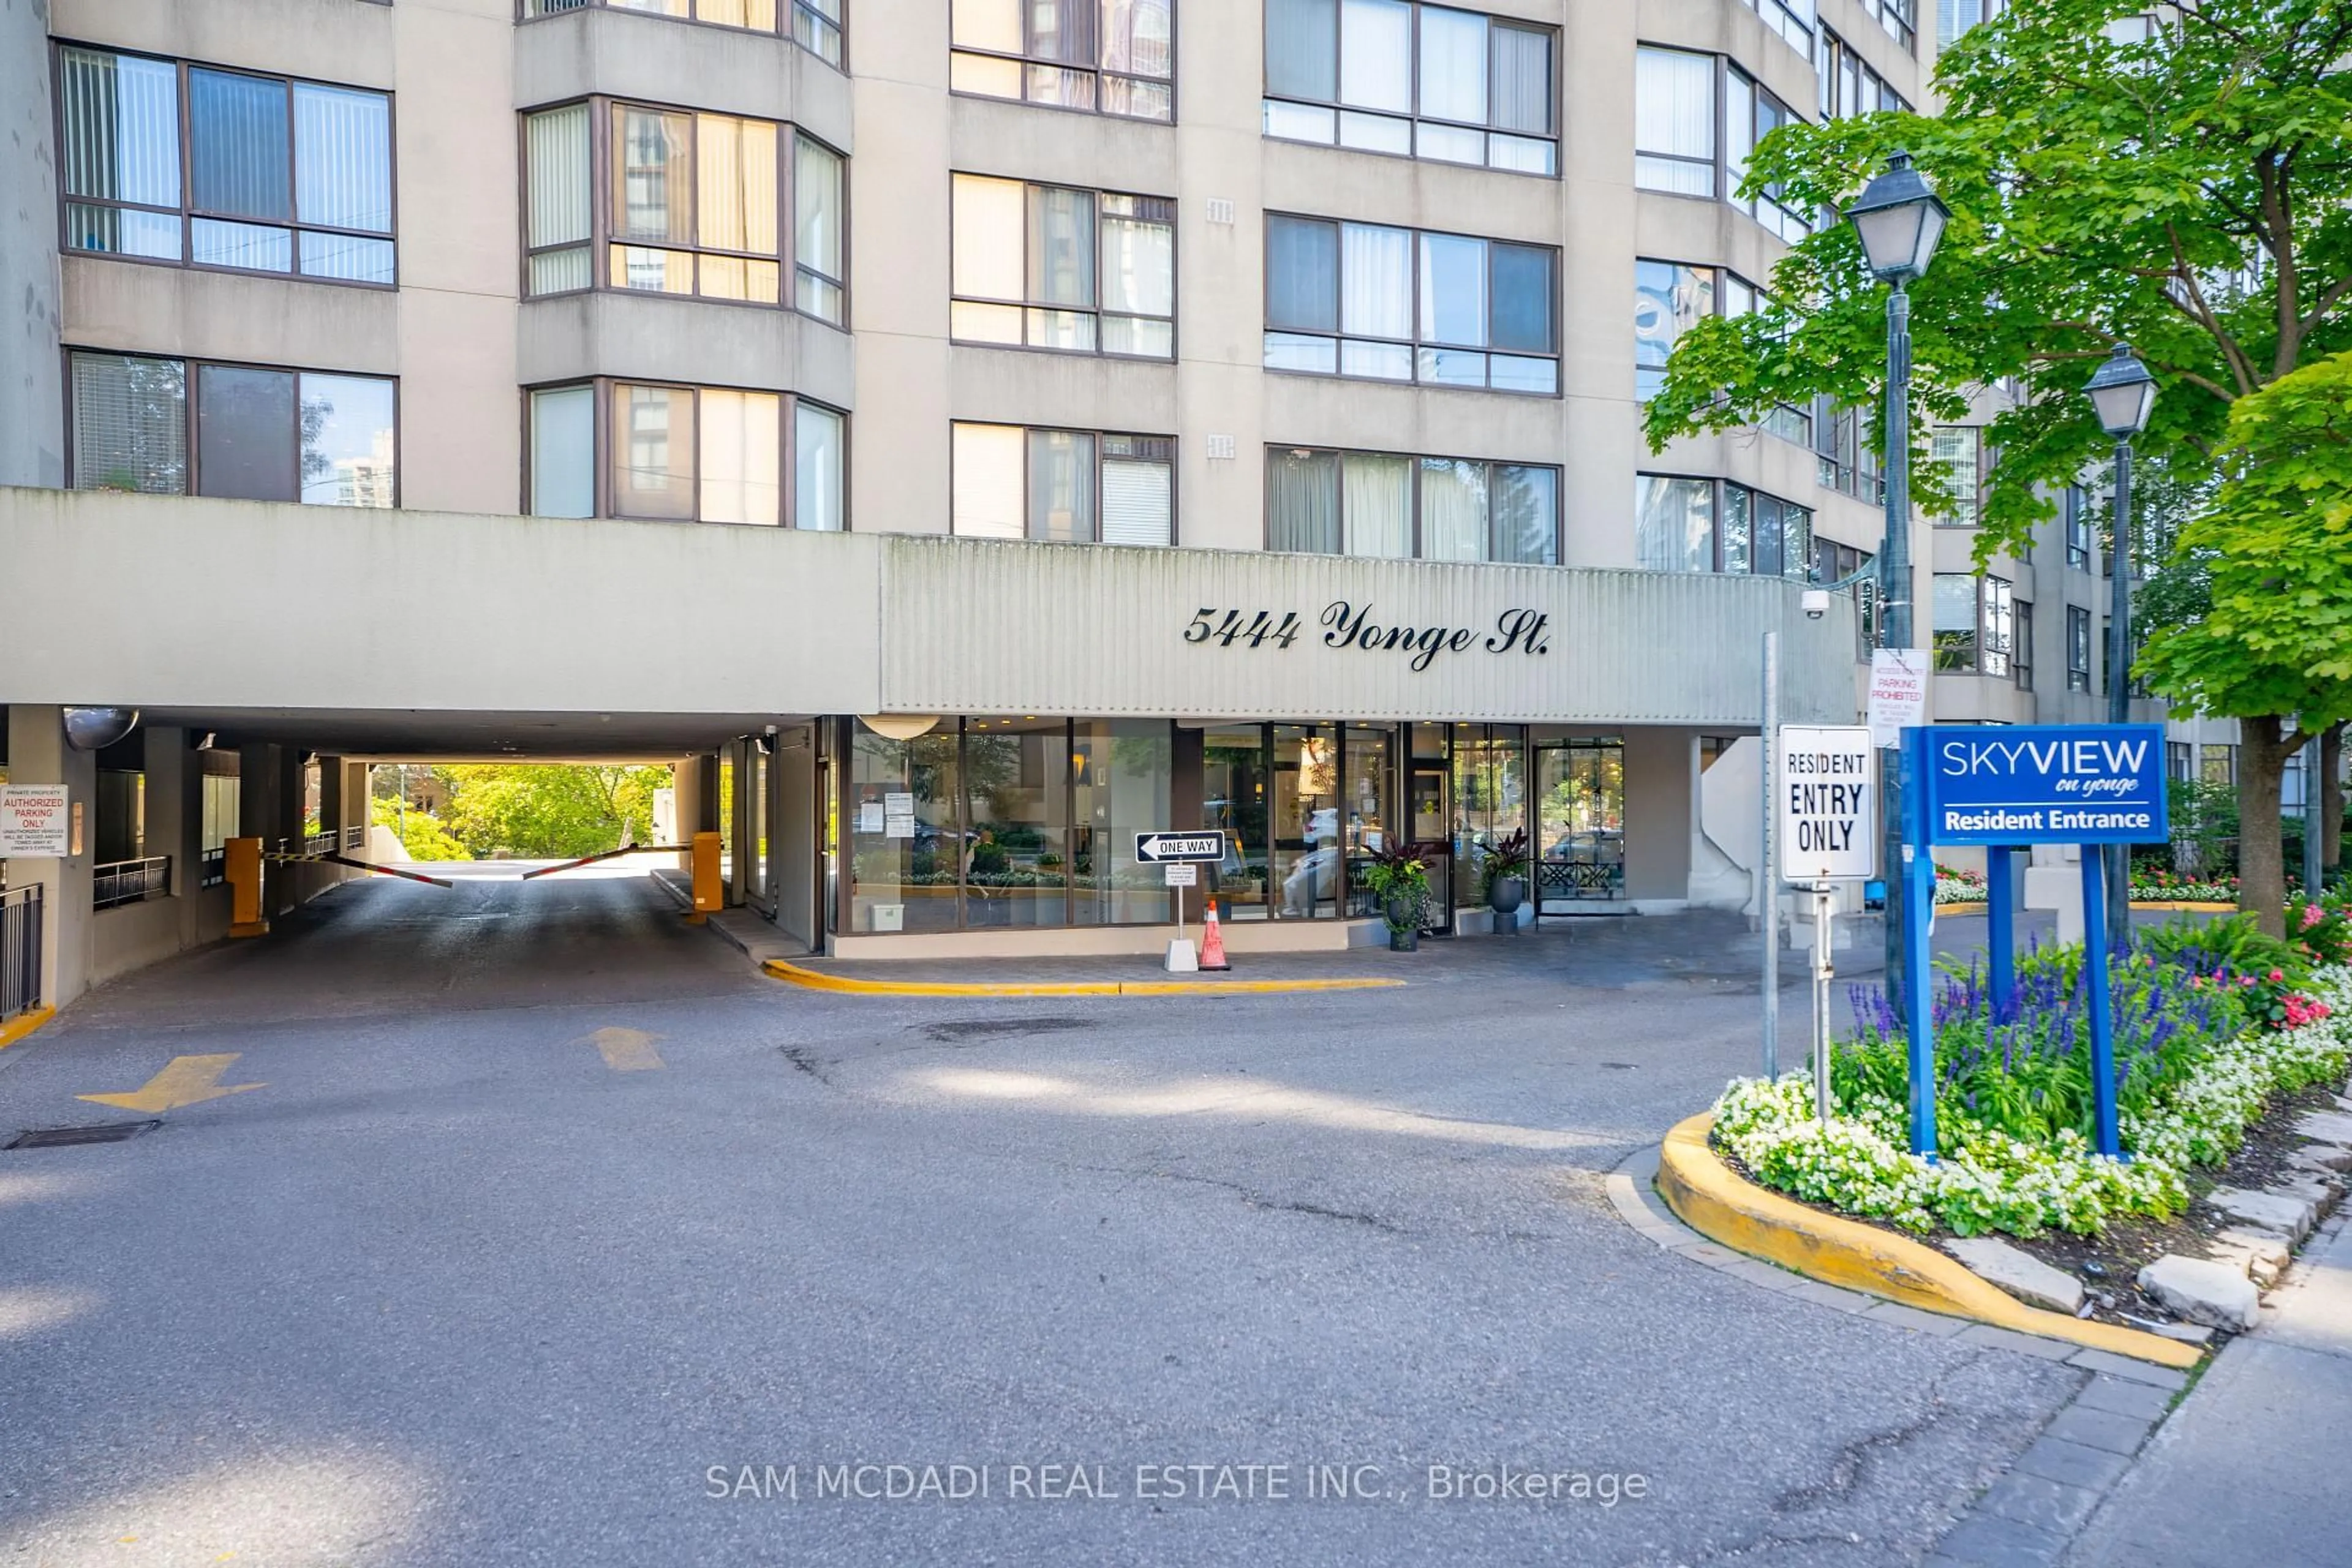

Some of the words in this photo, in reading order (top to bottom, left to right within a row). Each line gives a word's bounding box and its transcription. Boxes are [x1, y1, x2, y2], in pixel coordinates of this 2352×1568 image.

[1183, 606, 1303, 649] 5444
[1320, 601, 1481, 673] Yonge
[1485, 608, 1551, 654] St.
[1878, 678, 1917, 688] PARKING
[1872, 690, 1922, 701] PROHIBITED
[1787, 753, 1866, 774] RESIDENT
[1942, 740, 2148, 776] SKYVIEW
[2055, 778, 2081, 792] on
[2082, 777, 2139, 797] yonge
[4, 798, 64, 807] AUTHORIZED
[1791, 783, 1863, 815] ENTRY
[22, 819, 45, 828] ONLY
[1945, 810, 2044, 831] Resident
[2049, 809, 2150, 830] Entrance
[1798, 820, 1854, 852] ONLY
[1160, 841, 1183, 853] ONE
[1186, 840, 1213, 853] WAY
